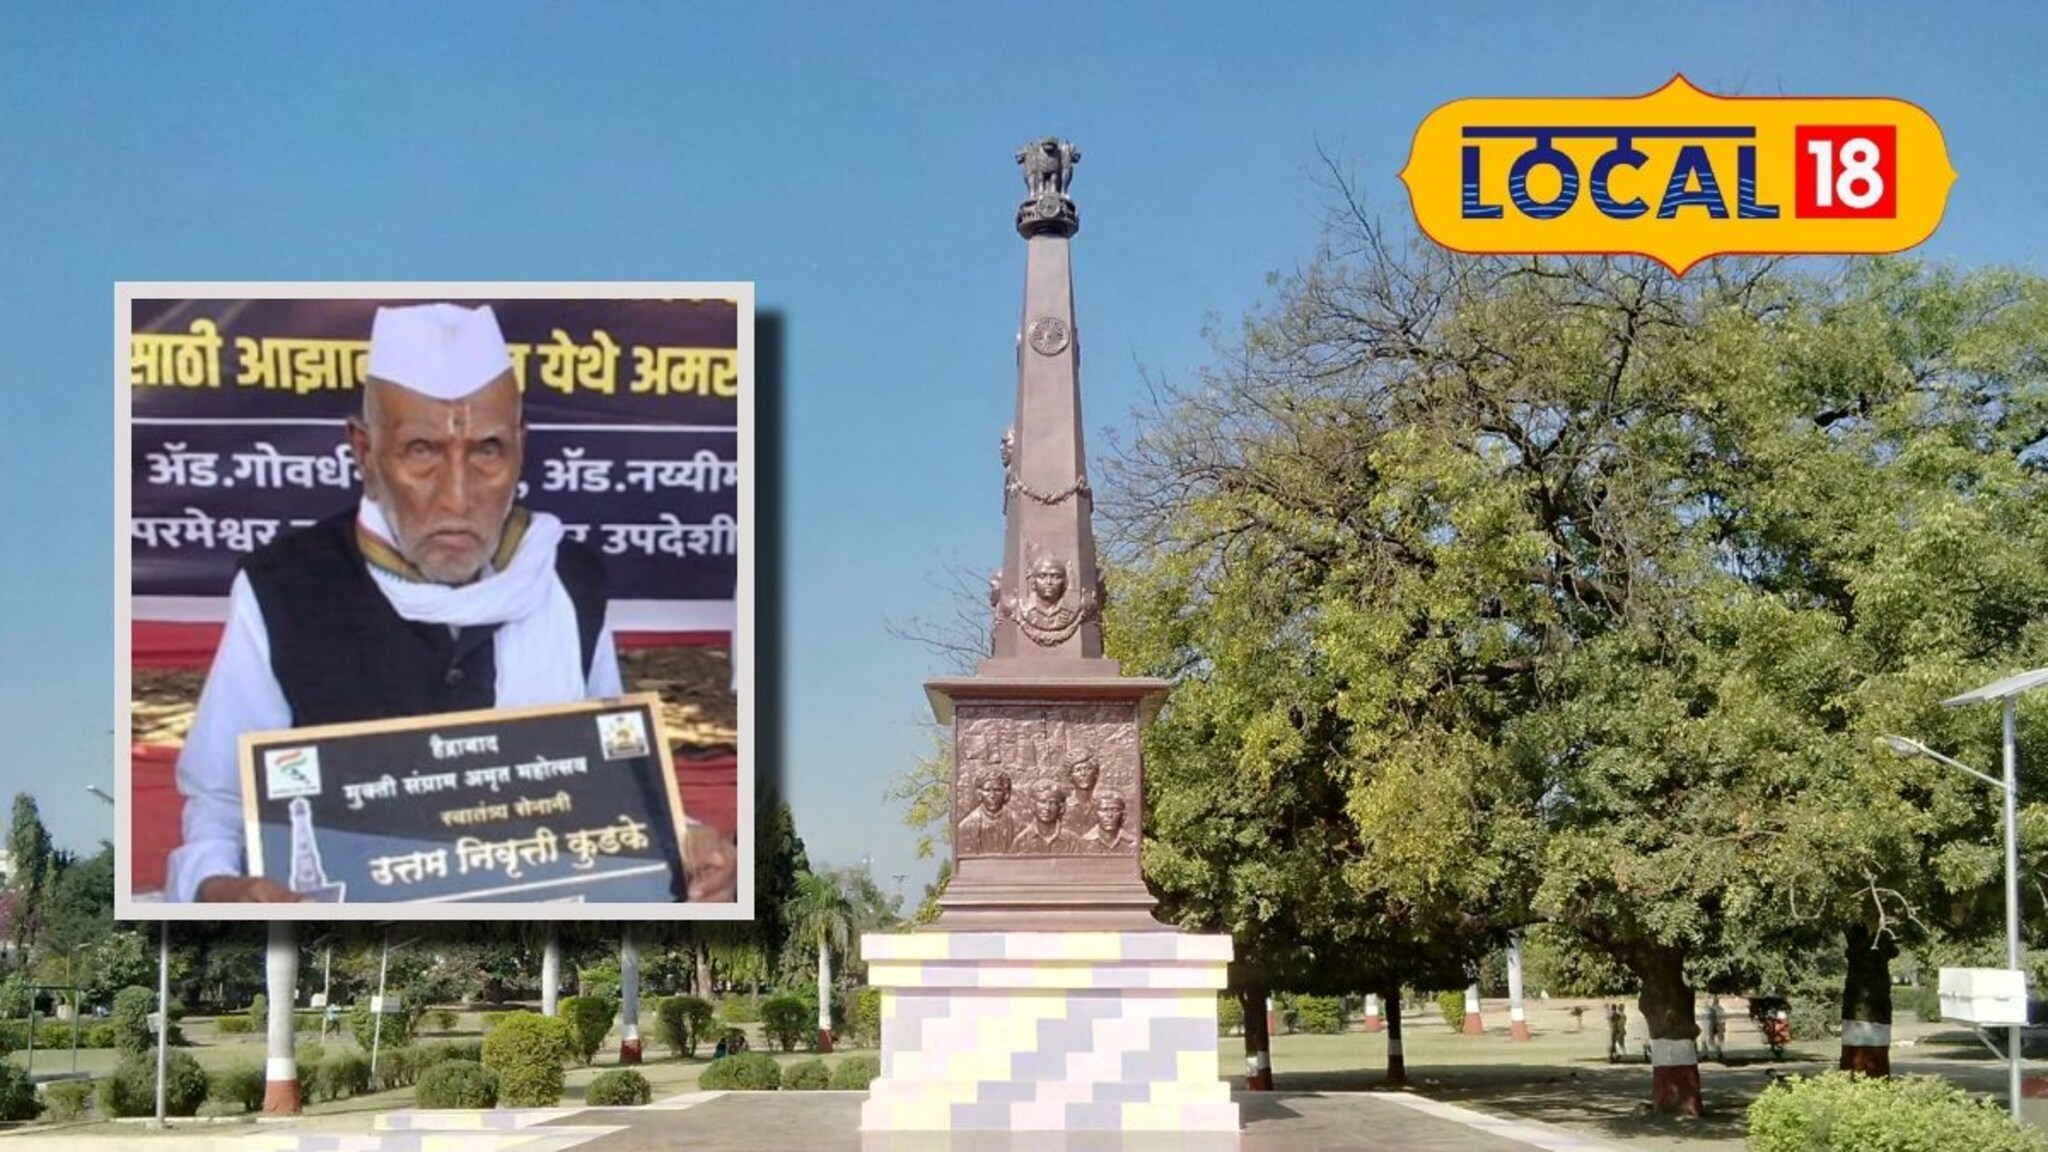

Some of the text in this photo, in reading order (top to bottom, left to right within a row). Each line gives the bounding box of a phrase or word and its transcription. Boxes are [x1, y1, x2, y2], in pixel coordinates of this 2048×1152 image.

[536, 328, 621, 394] येथे
[342, 754, 588, 809] मुक्ती संग्राम अमृत महोत्सव
[368, 814, 649, 885] उत्तम निवृत्ती कुडके
